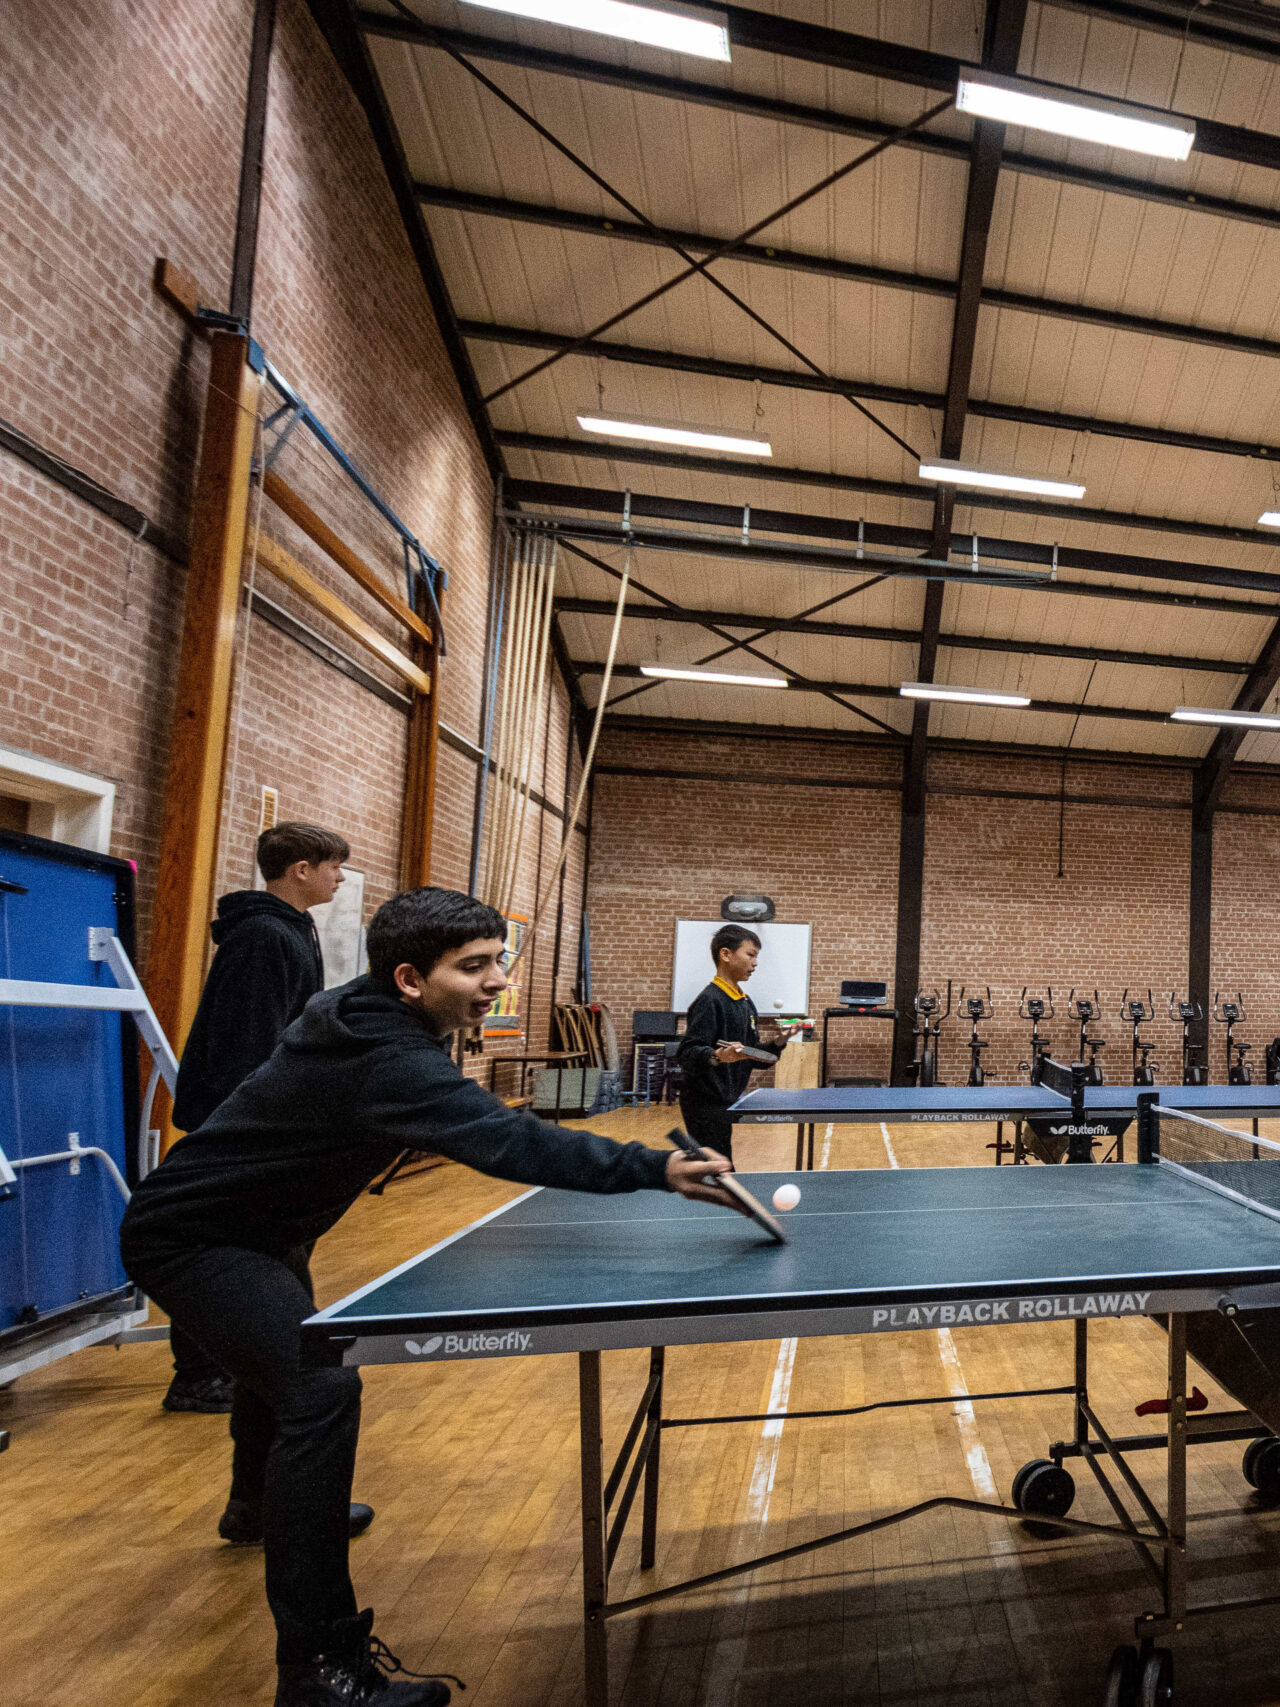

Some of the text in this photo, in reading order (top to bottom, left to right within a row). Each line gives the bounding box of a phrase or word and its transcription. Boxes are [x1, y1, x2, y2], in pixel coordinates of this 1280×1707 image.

[911, 1113, 1010, 1121] PLAYBACK ROLLAWAY
[1068, 1124, 1109, 1135] Butterfly
[872, 1292, 1151, 1328] PLAYBACK ROLLAWAY
[444, 1330, 532, 1354] Butterfly
